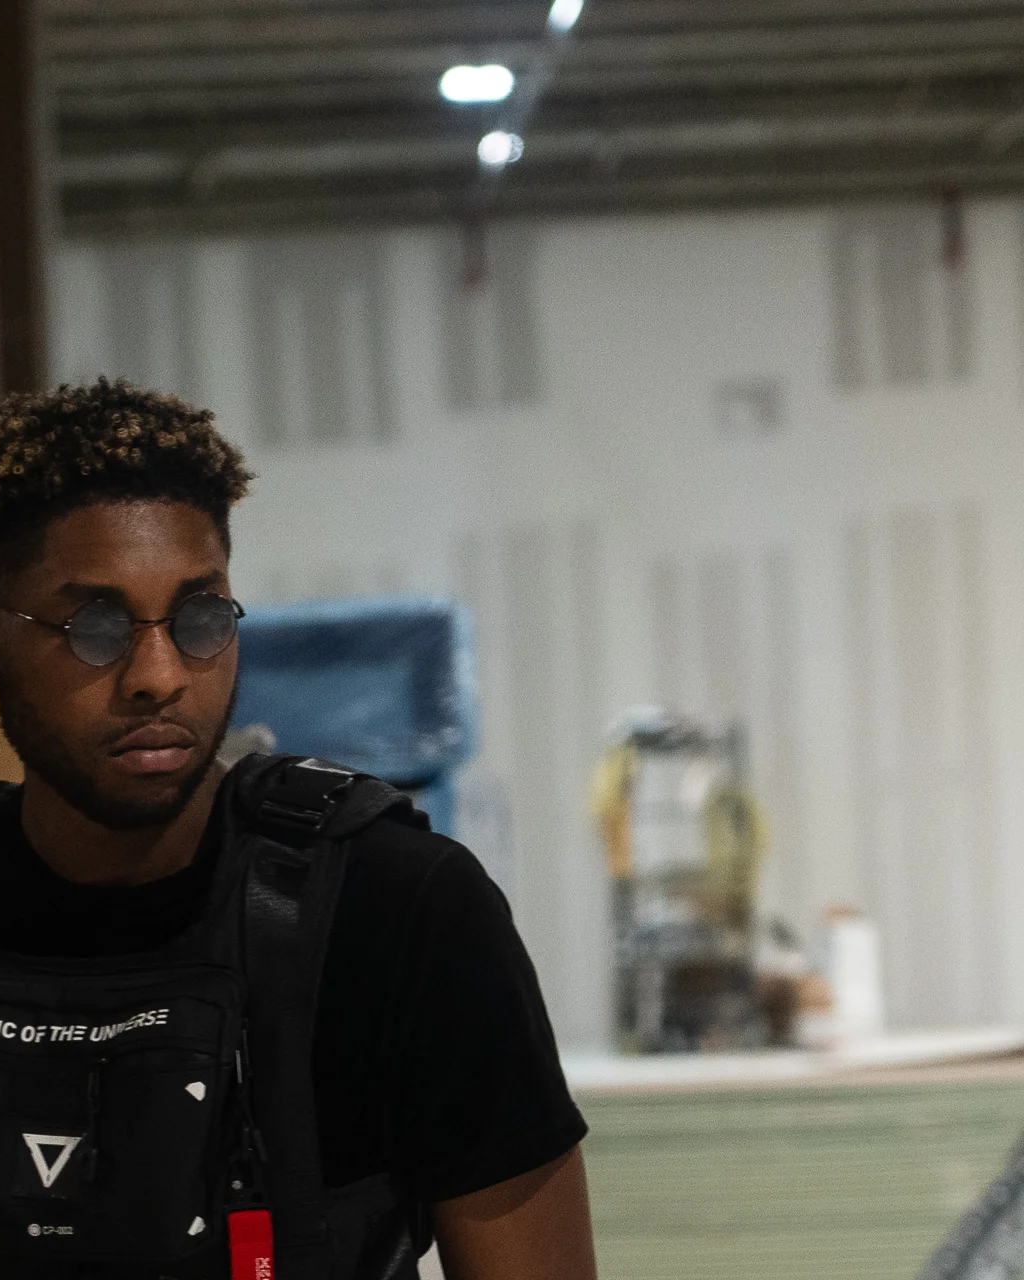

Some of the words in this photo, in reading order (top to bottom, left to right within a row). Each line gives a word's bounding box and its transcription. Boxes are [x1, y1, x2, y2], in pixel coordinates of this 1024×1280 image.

[20, 1025, 48, 1043] OF
[49, 1024, 88, 1042] THE
[89, 1008, 170, 1042] UNIVERSE
